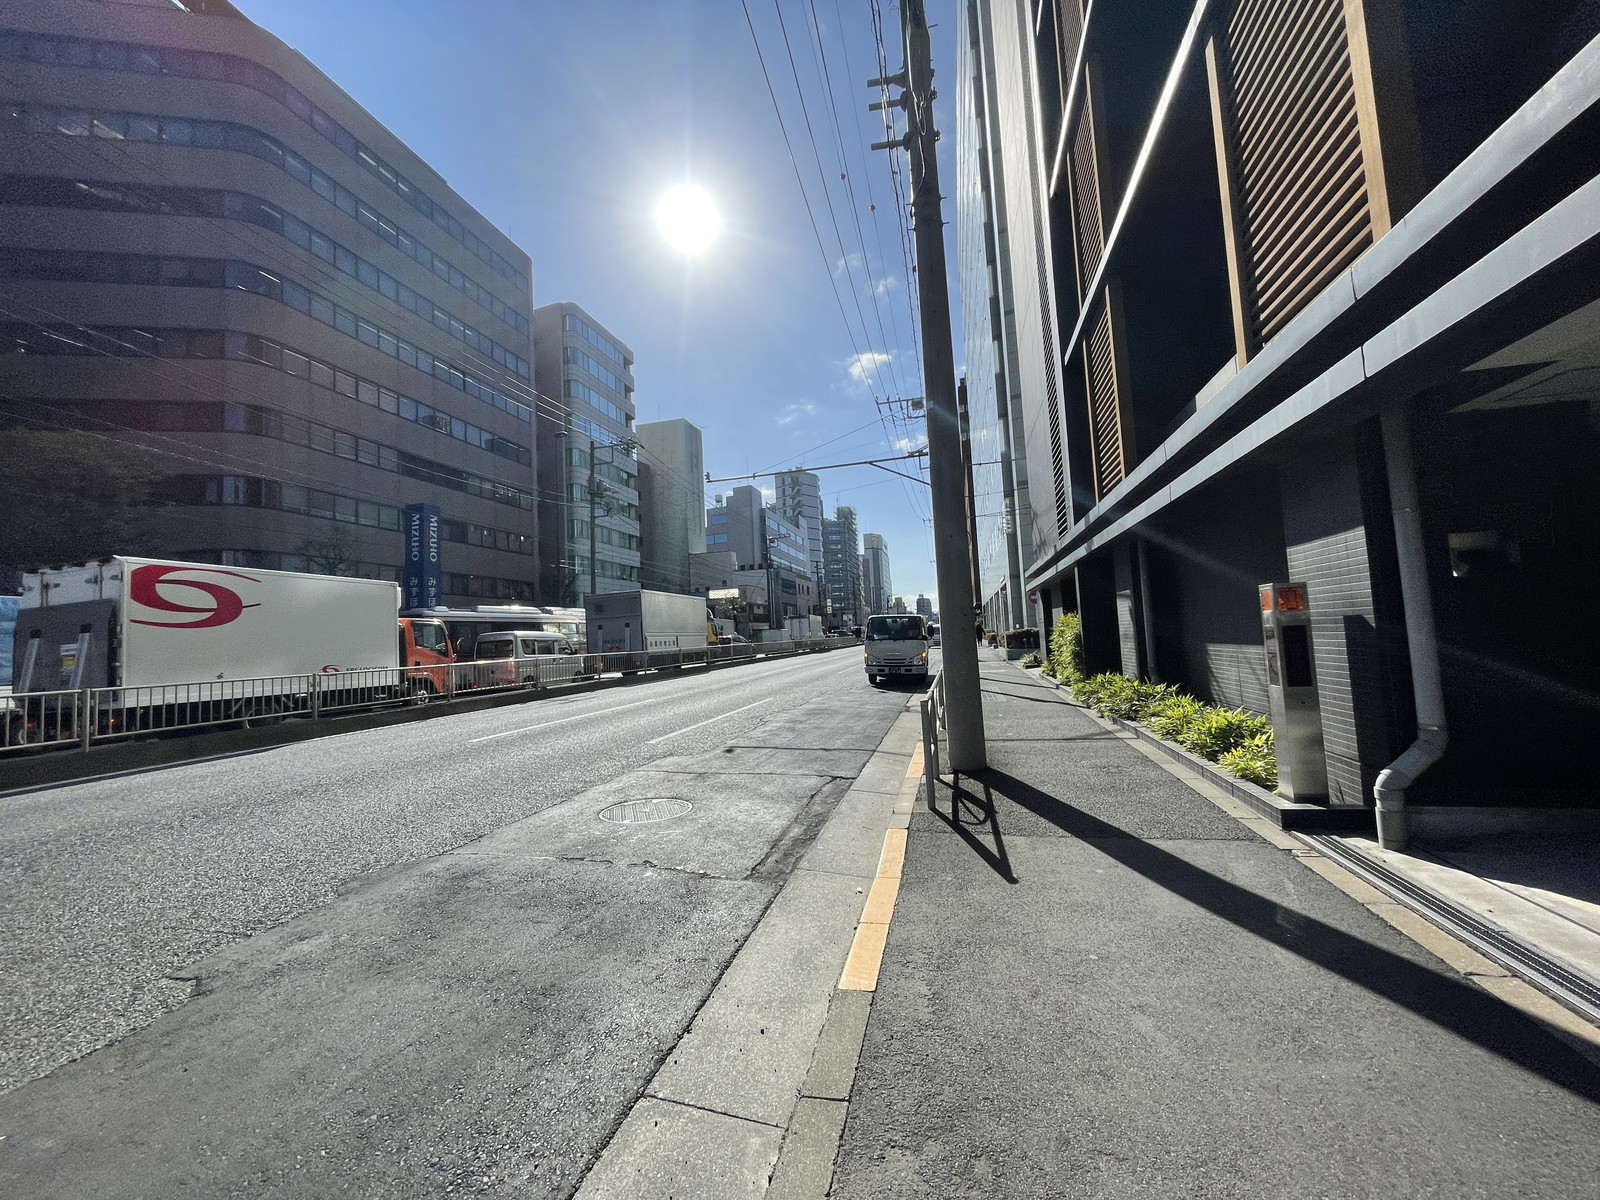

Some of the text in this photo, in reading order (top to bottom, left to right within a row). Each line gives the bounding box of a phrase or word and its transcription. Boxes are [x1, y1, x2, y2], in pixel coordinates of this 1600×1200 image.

[411, 513, 420, 561] MIZUHO
[429, 514, 438, 562] MIZUHO
[409, 576, 419, 607] みずほ
[428, 576, 437, 607] みずほ
